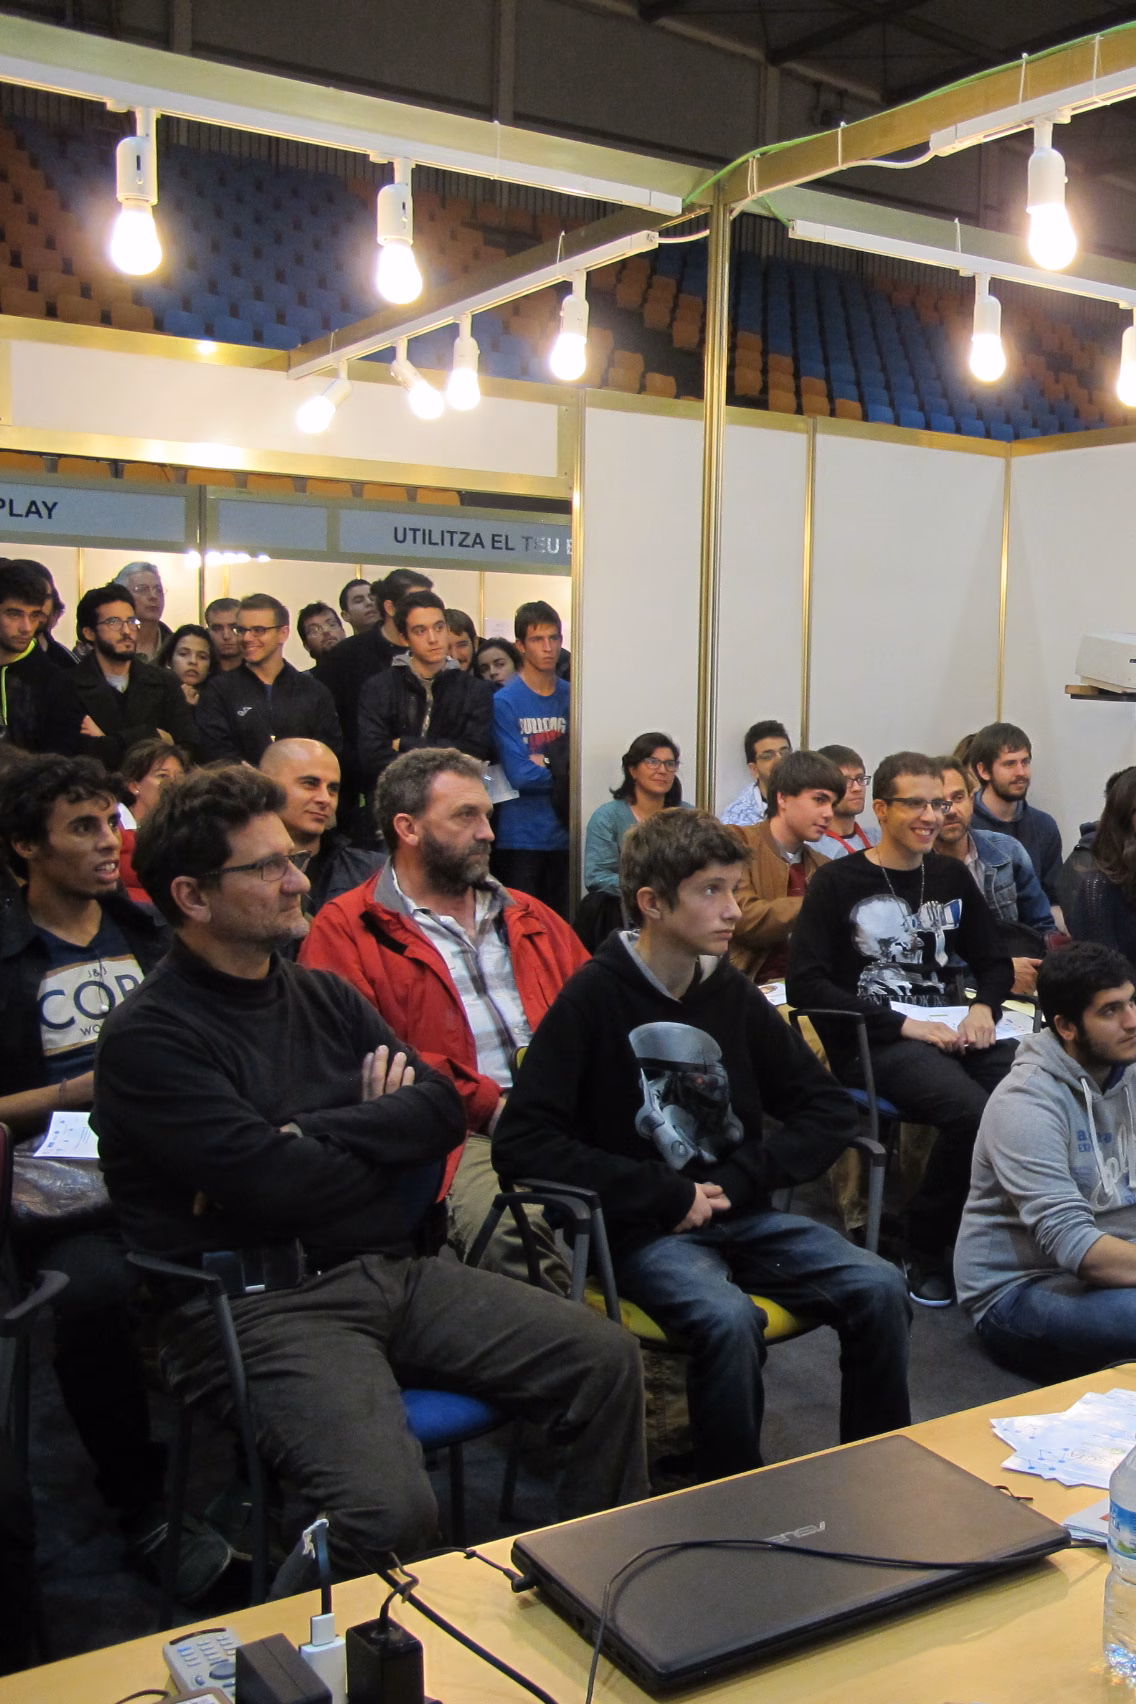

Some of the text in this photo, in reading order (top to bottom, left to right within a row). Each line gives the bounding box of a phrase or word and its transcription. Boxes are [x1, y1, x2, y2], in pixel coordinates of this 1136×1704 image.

[0, 497, 58, 519] PLAY
[394, 526, 485, 549] UTILITZA
[491, 533, 515, 551] EL
